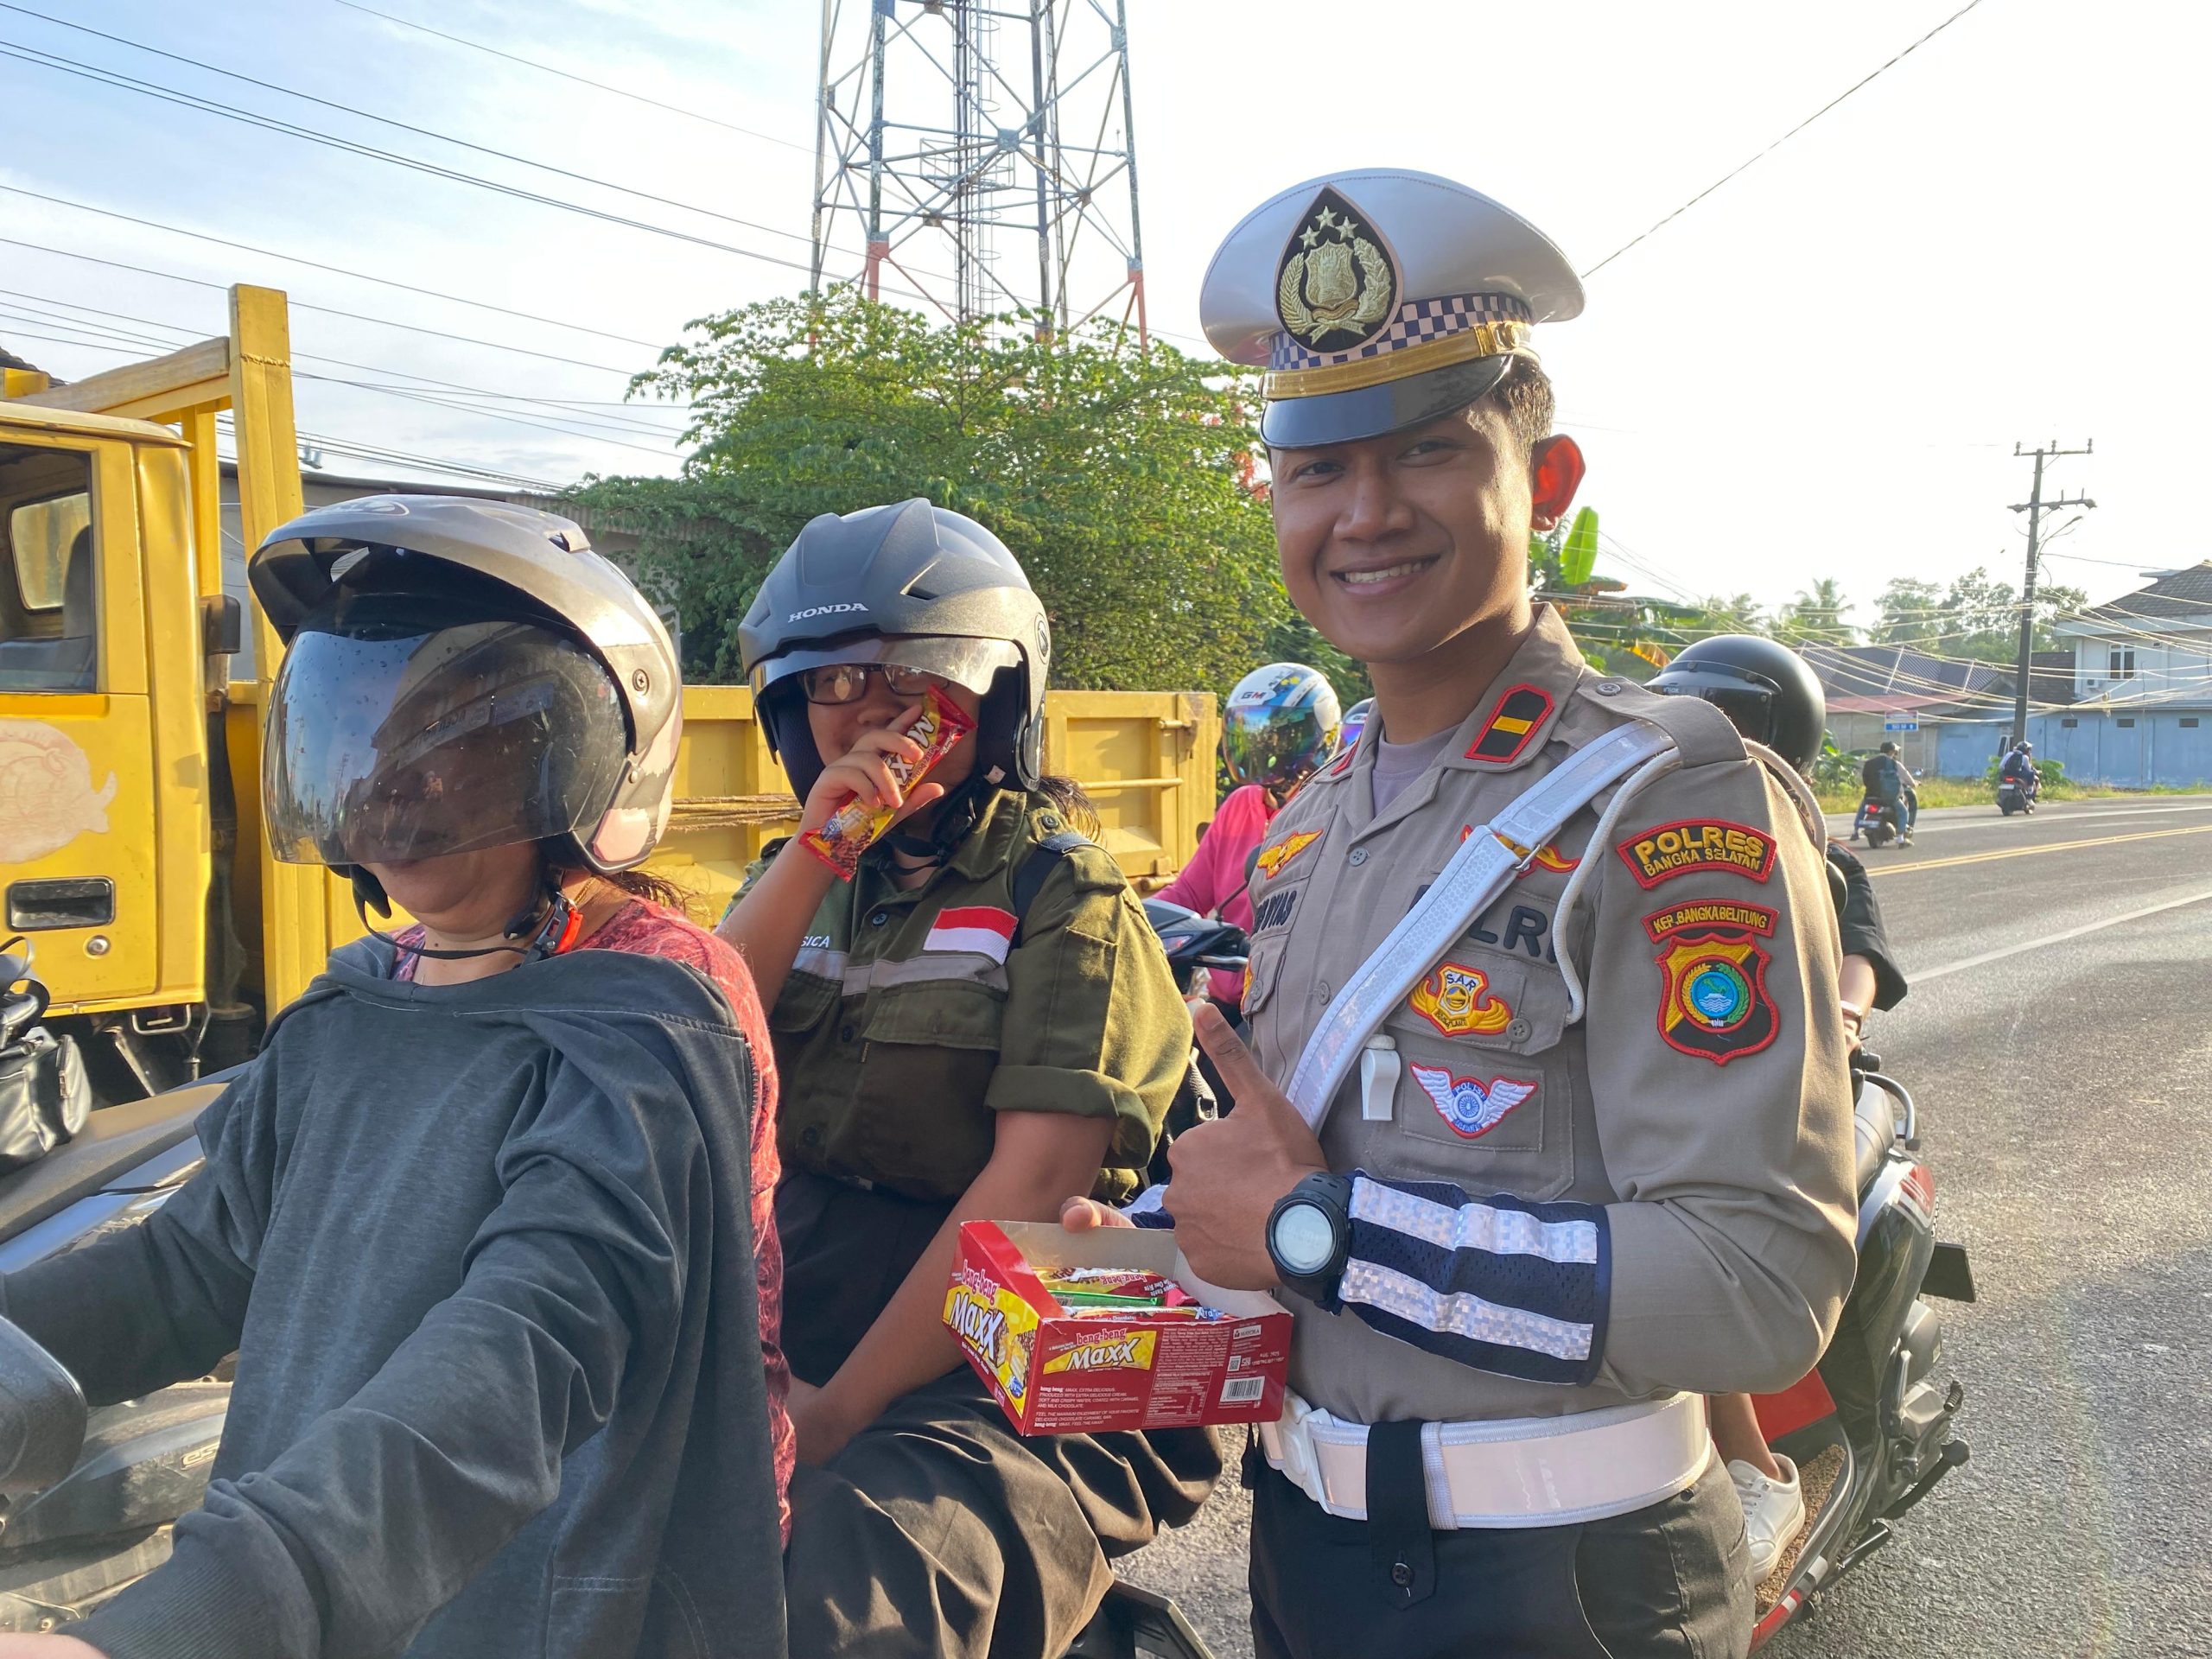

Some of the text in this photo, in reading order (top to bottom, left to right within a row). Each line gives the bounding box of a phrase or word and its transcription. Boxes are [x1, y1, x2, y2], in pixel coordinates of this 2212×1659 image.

[787, 602, 869, 623] HONDA
[1241, 691, 1267, 700] GM
[1635, 826, 1764, 864] POLRES
[1643, 848, 1761, 876] BANGKA SELATAN
[1446, 974, 1477, 992] SAR
[961, 1258, 999, 1306] beng-beng
[1076, 1327, 1128, 1346] beng-beng
